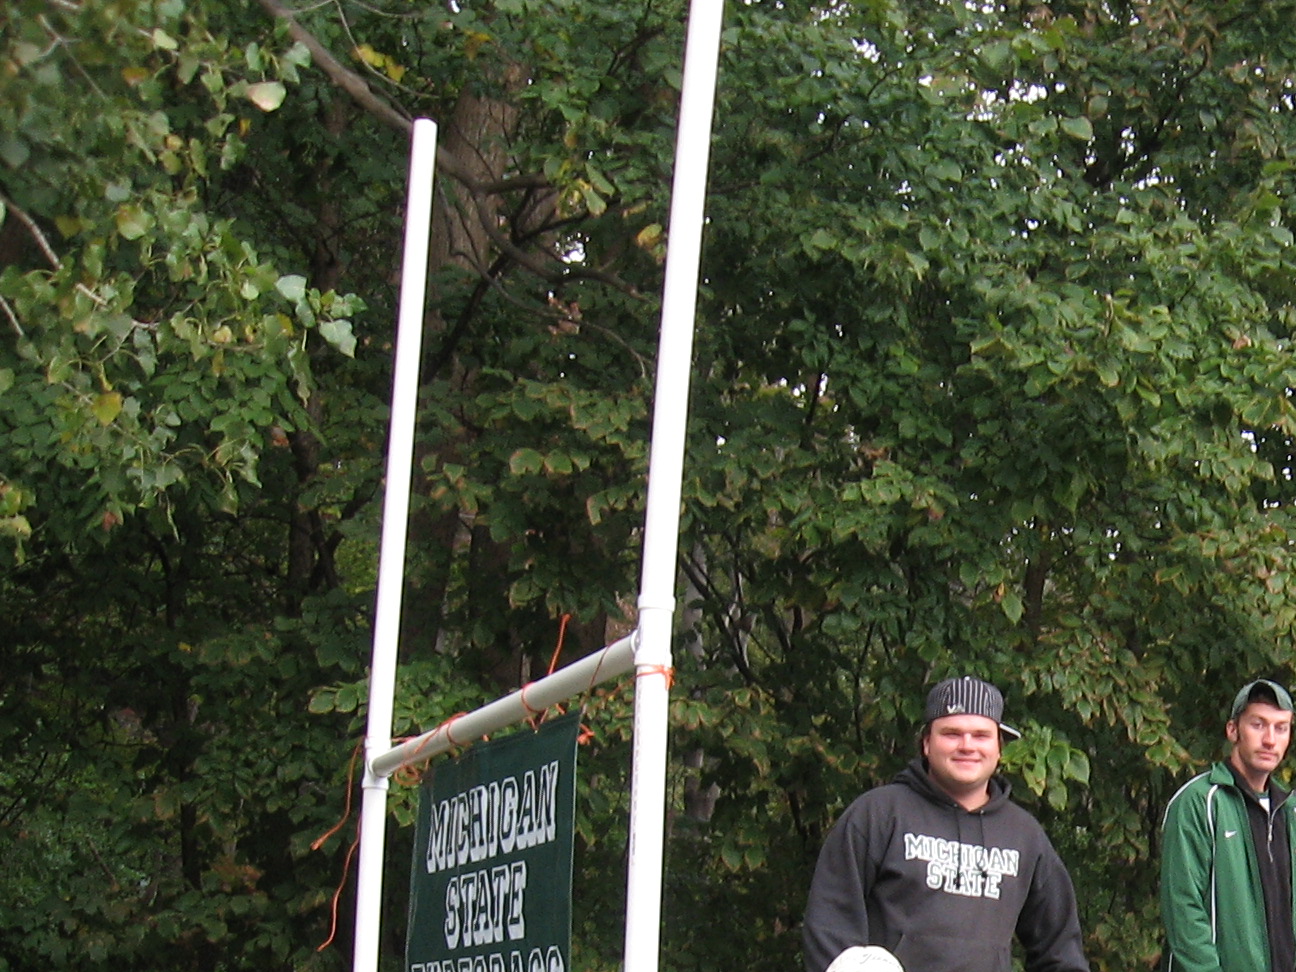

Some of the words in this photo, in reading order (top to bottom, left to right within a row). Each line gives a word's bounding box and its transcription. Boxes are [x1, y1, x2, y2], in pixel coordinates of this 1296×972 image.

[427, 760, 559, 874] MICHIGAN
[904, 833, 1020, 877] MICHIGAN
[926, 861, 1002, 900] STATE
[444, 860, 526, 950] STATE
